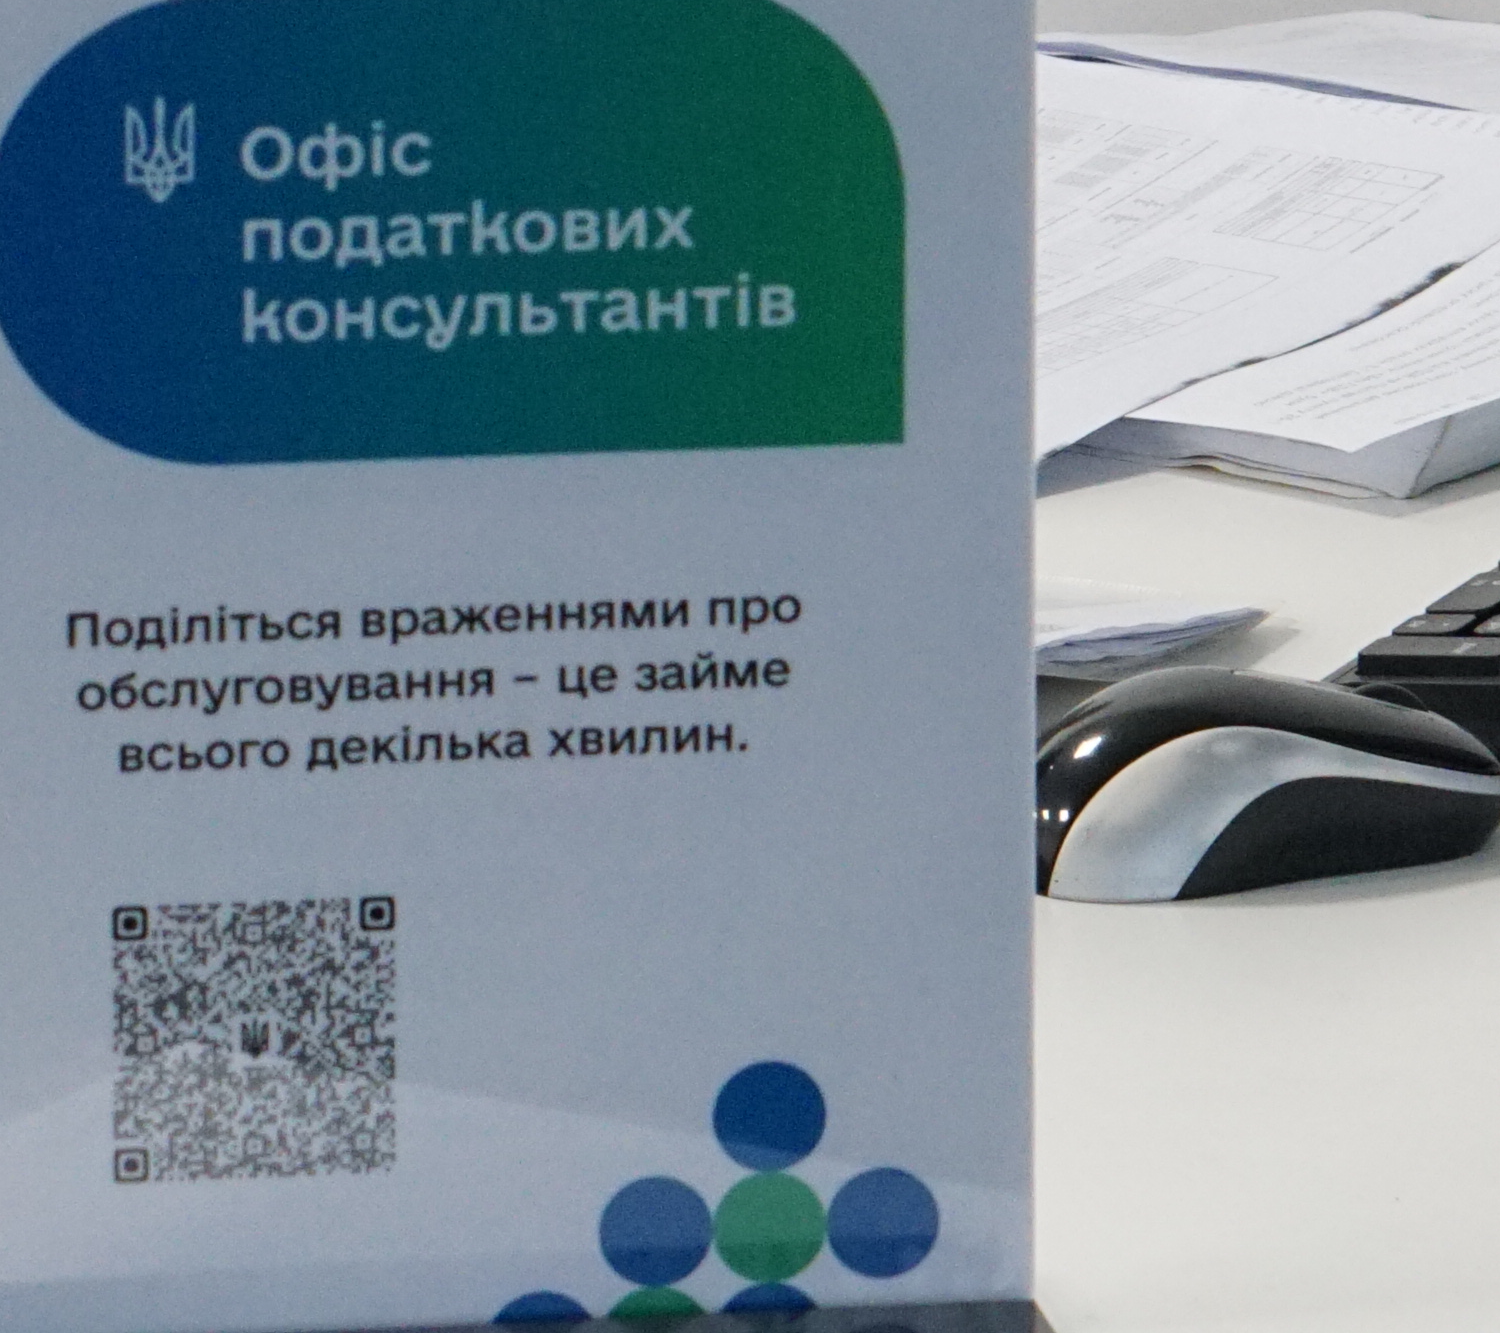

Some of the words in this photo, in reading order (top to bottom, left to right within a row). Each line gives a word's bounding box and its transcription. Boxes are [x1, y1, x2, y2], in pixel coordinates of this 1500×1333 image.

[239, 119, 432, 192] Офіс
[242, 198, 694, 269] податкових
[242, 263, 796, 352] консультантів
[65, 604, 342, 652] Поділіться
[359, 598, 690, 646] враженнями
[707, 593, 803, 635] про
[75, 666, 495, 717] обслуговування
[557, 662, 619, 700] це
[634, 650, 792, 693] займе
[117, 737, 292, 775] всього
[305, 725, 532, 774] декілька
[547, 722, 749, 758] хвилин.
